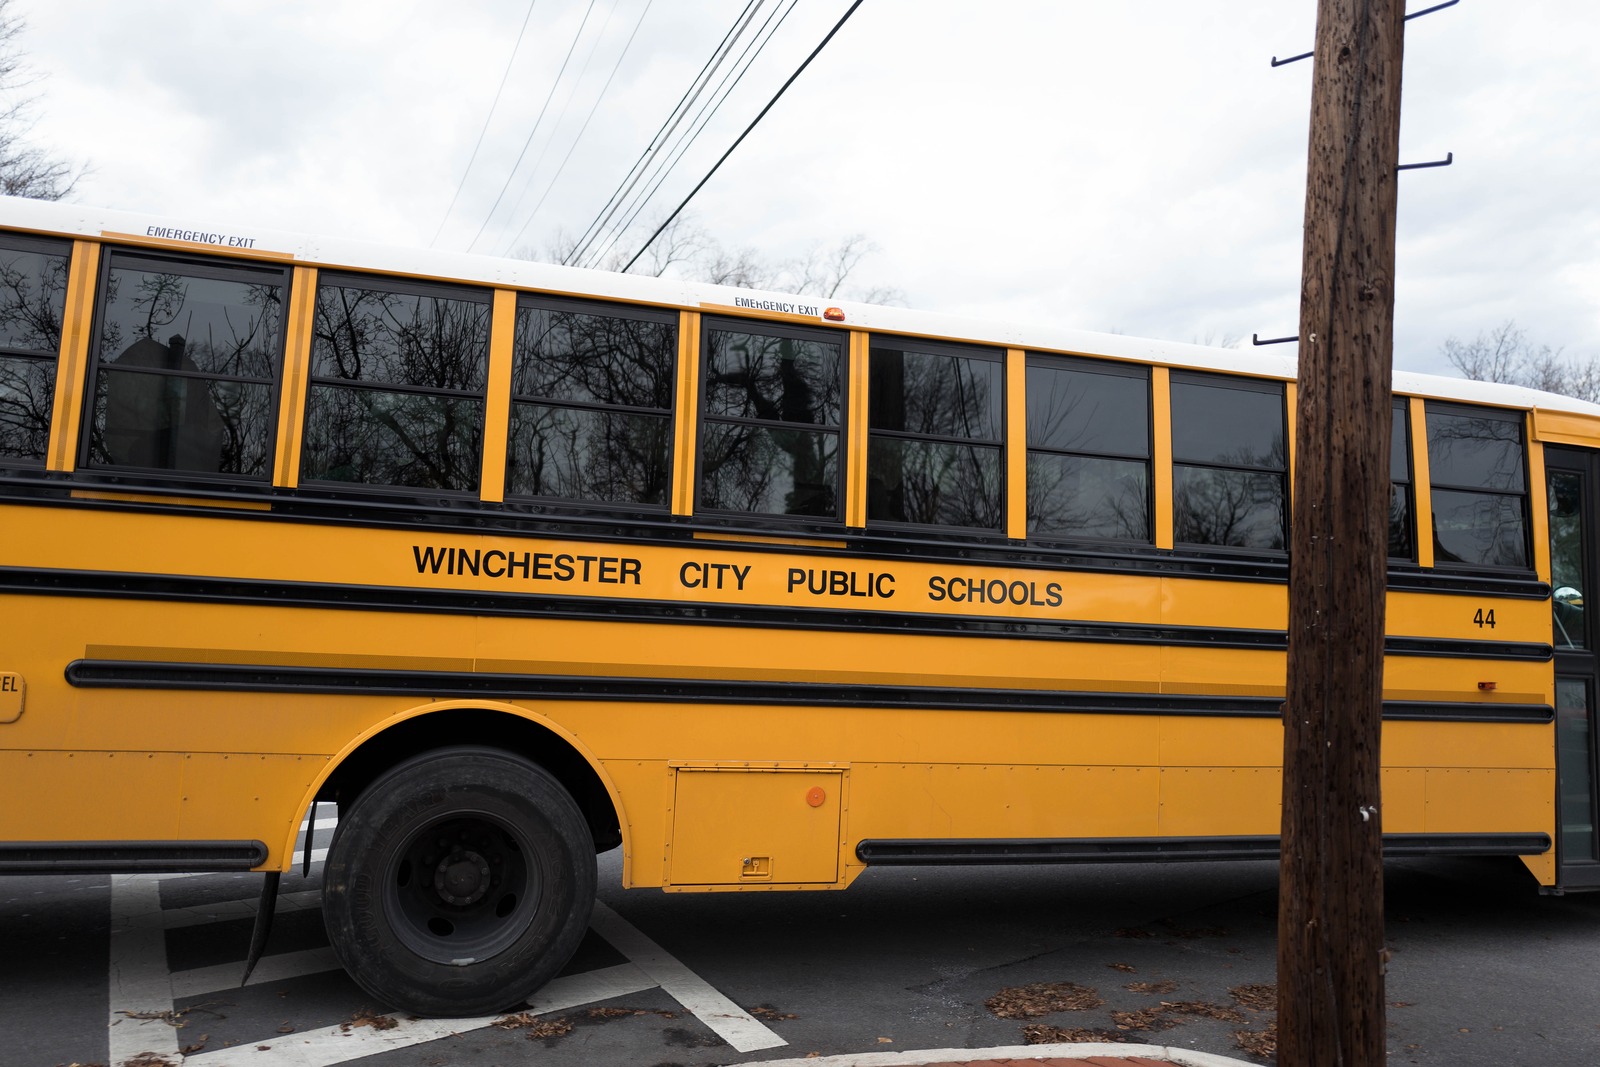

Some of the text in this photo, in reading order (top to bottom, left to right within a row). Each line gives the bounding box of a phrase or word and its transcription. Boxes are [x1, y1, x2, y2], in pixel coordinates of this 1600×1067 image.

[146, 225, 256, 249] EMERGENCY EXIT
[734, 297, 819, 316] EMERGENCY EXIT
[412, 545, 1063, 607] WINCHESTER CITY PUBLIC SCHOOLS
[1473, 608, 1496, 629] 44
[0, 676, 18, 692] EL
